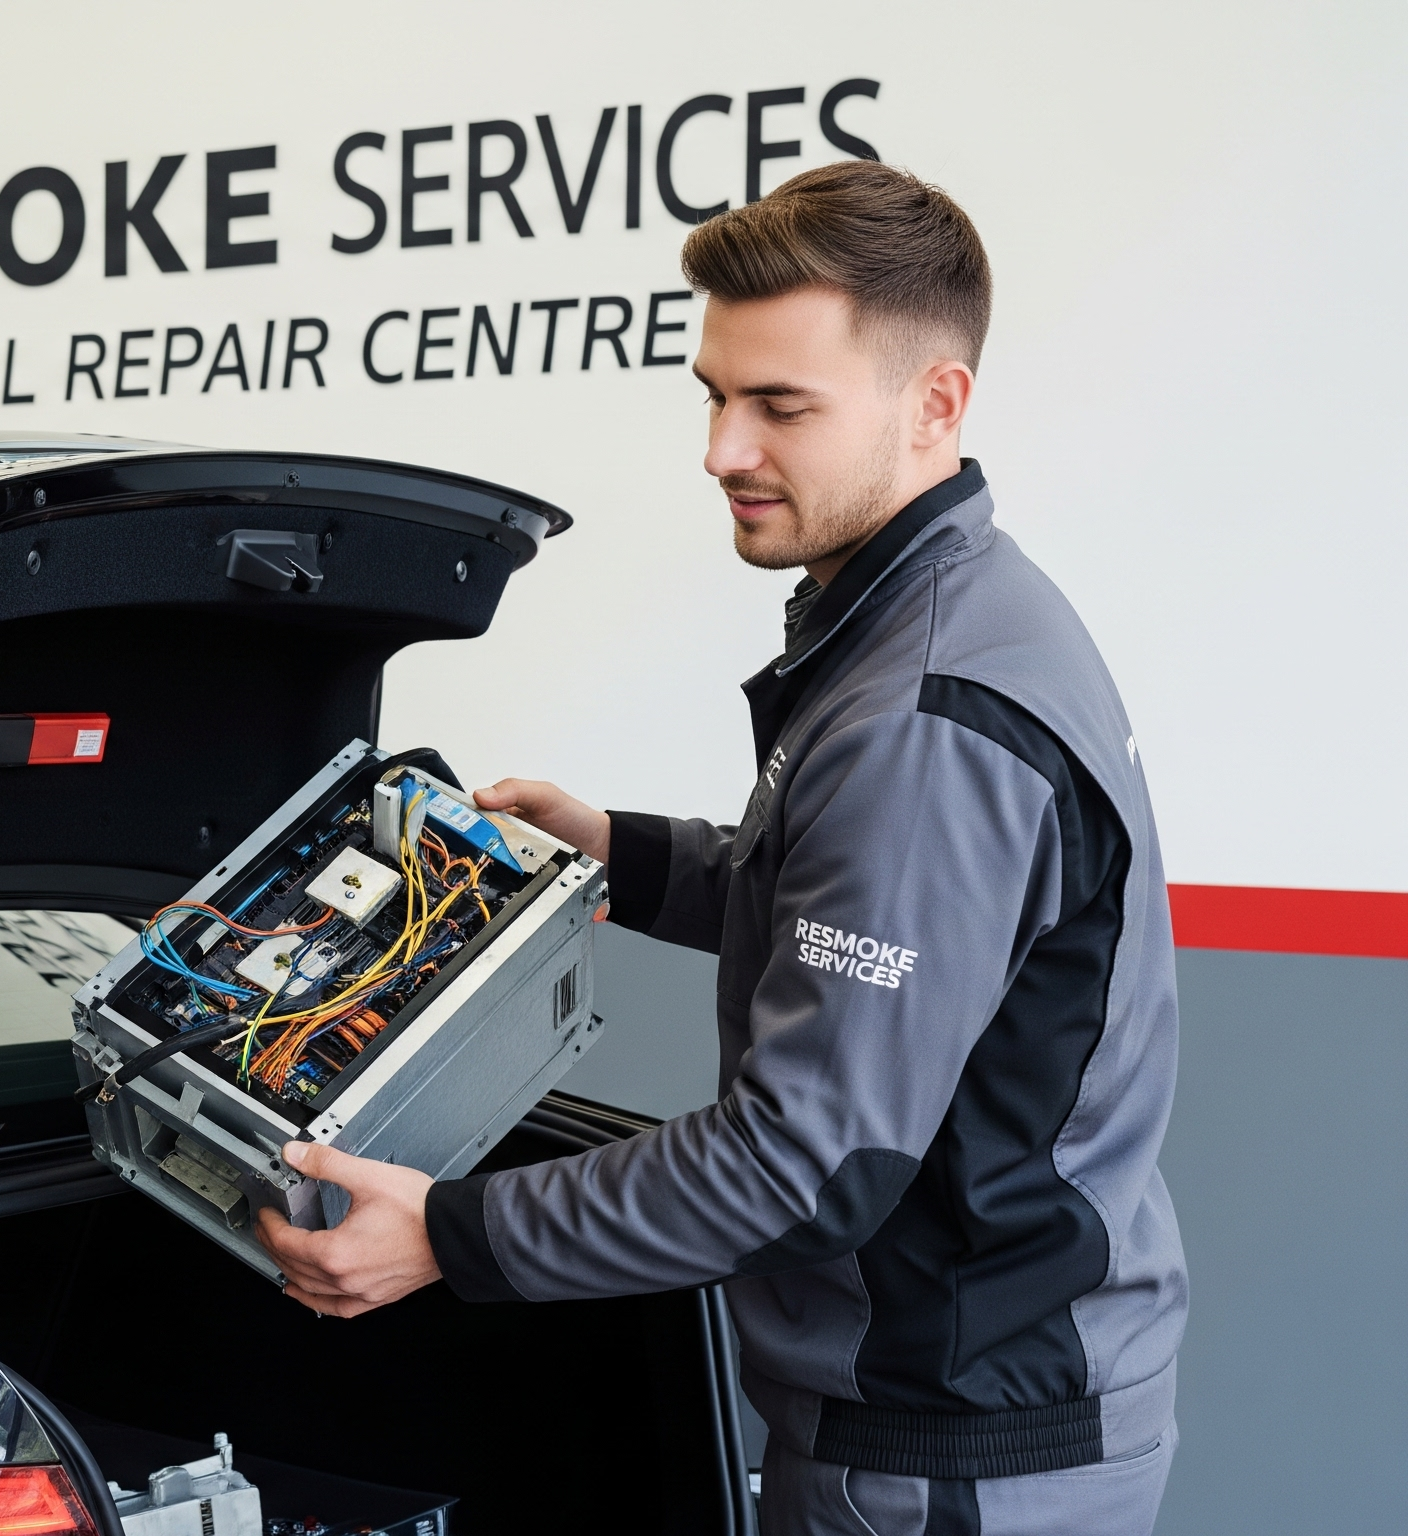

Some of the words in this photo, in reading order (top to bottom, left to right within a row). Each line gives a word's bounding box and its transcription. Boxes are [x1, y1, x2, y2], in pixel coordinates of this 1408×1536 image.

[64, 317, 330, 402] REPAIR
[361, 289, 693, 385] CENTRE
[795, 917, 919, 973] RESMOKE
[797, 943, 903, 989] SERVICES
